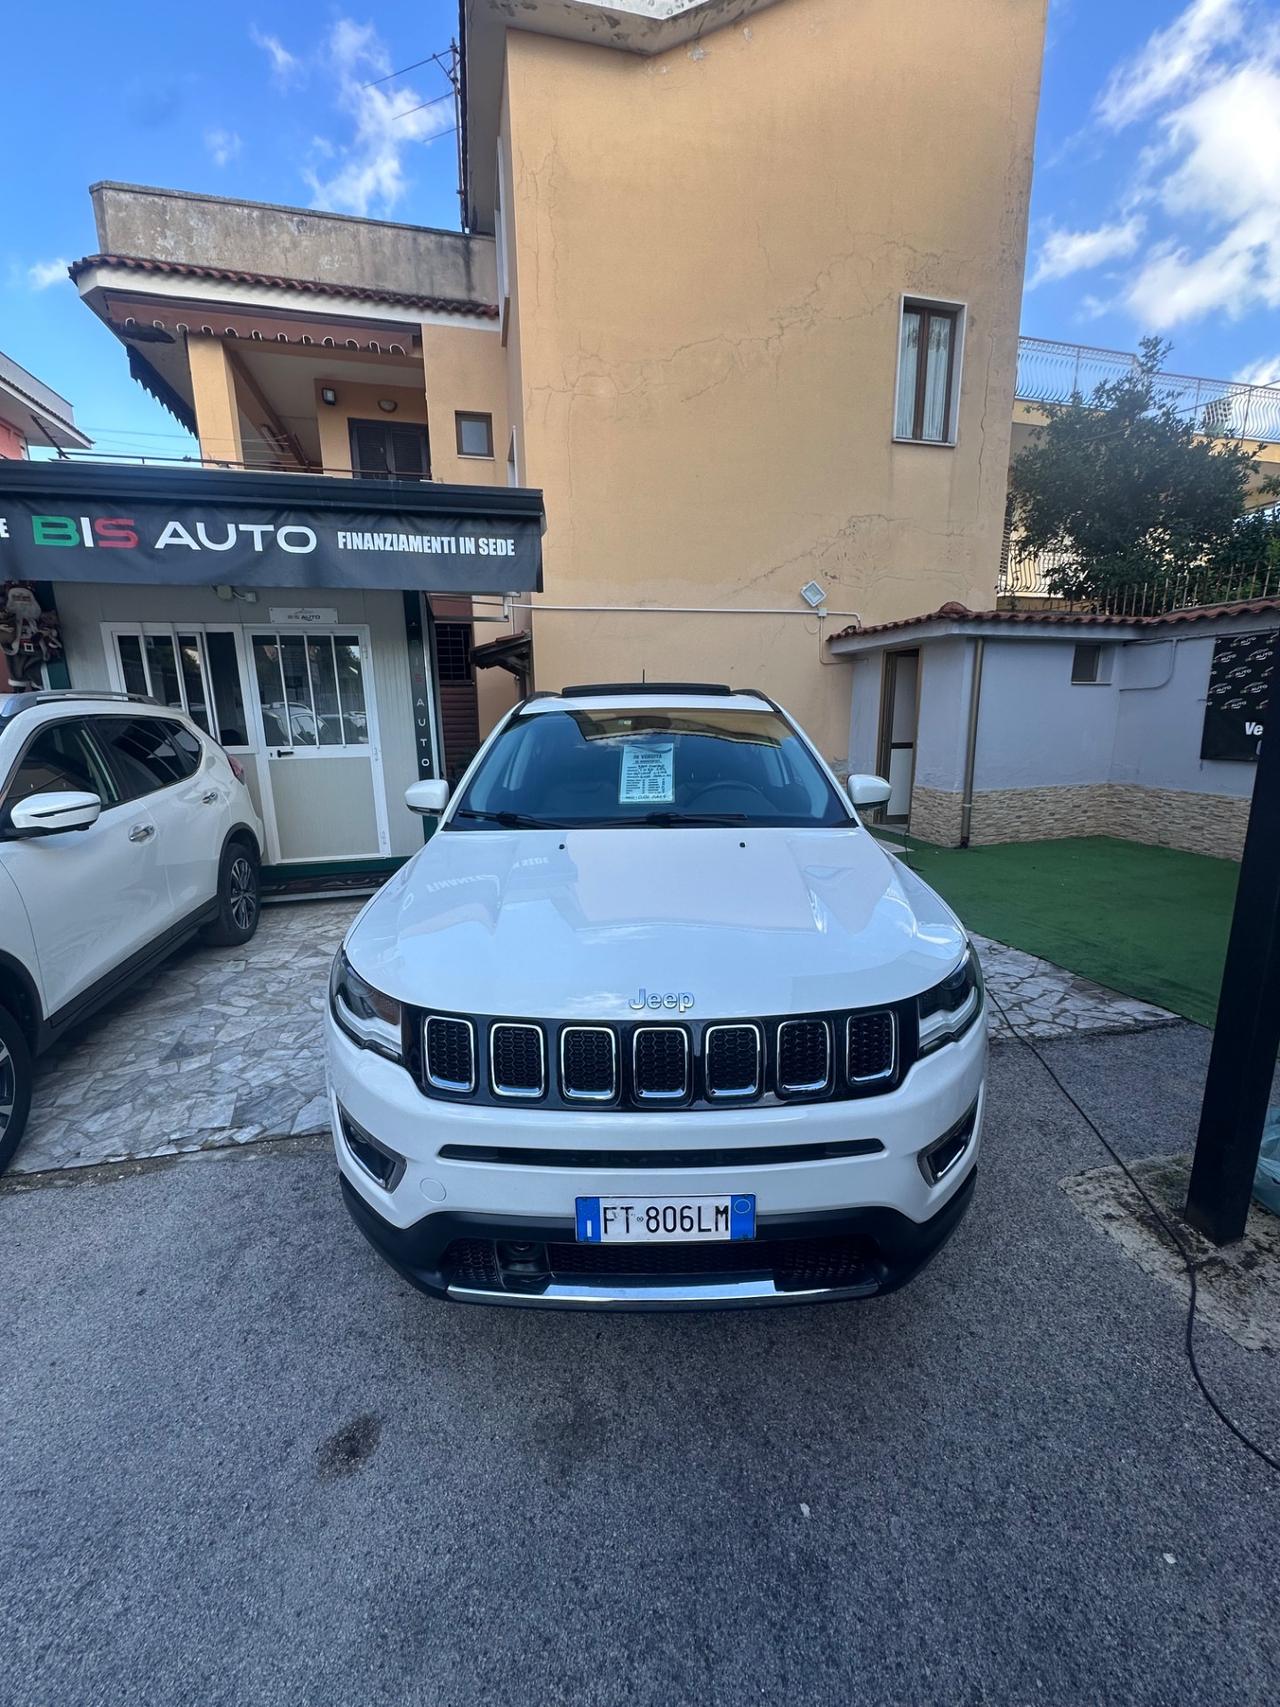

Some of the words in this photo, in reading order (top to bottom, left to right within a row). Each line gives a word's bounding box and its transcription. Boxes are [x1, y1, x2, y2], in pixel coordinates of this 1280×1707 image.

[31, 515, 139, 549] BIS
[154, 520, 318, 554] AUTO
[337, 531, 457, 554] FINANZIAMENTI
[459, 537, 476, 555] IN
[478, 538, 516, 556] SEDE
[1245, 721, 1264, 735] Ve
[629, 988, 695, 1013] Jeep
[603, 1206, 635, 1234] FT
[645, 1205, 729, 1234] 806LM
